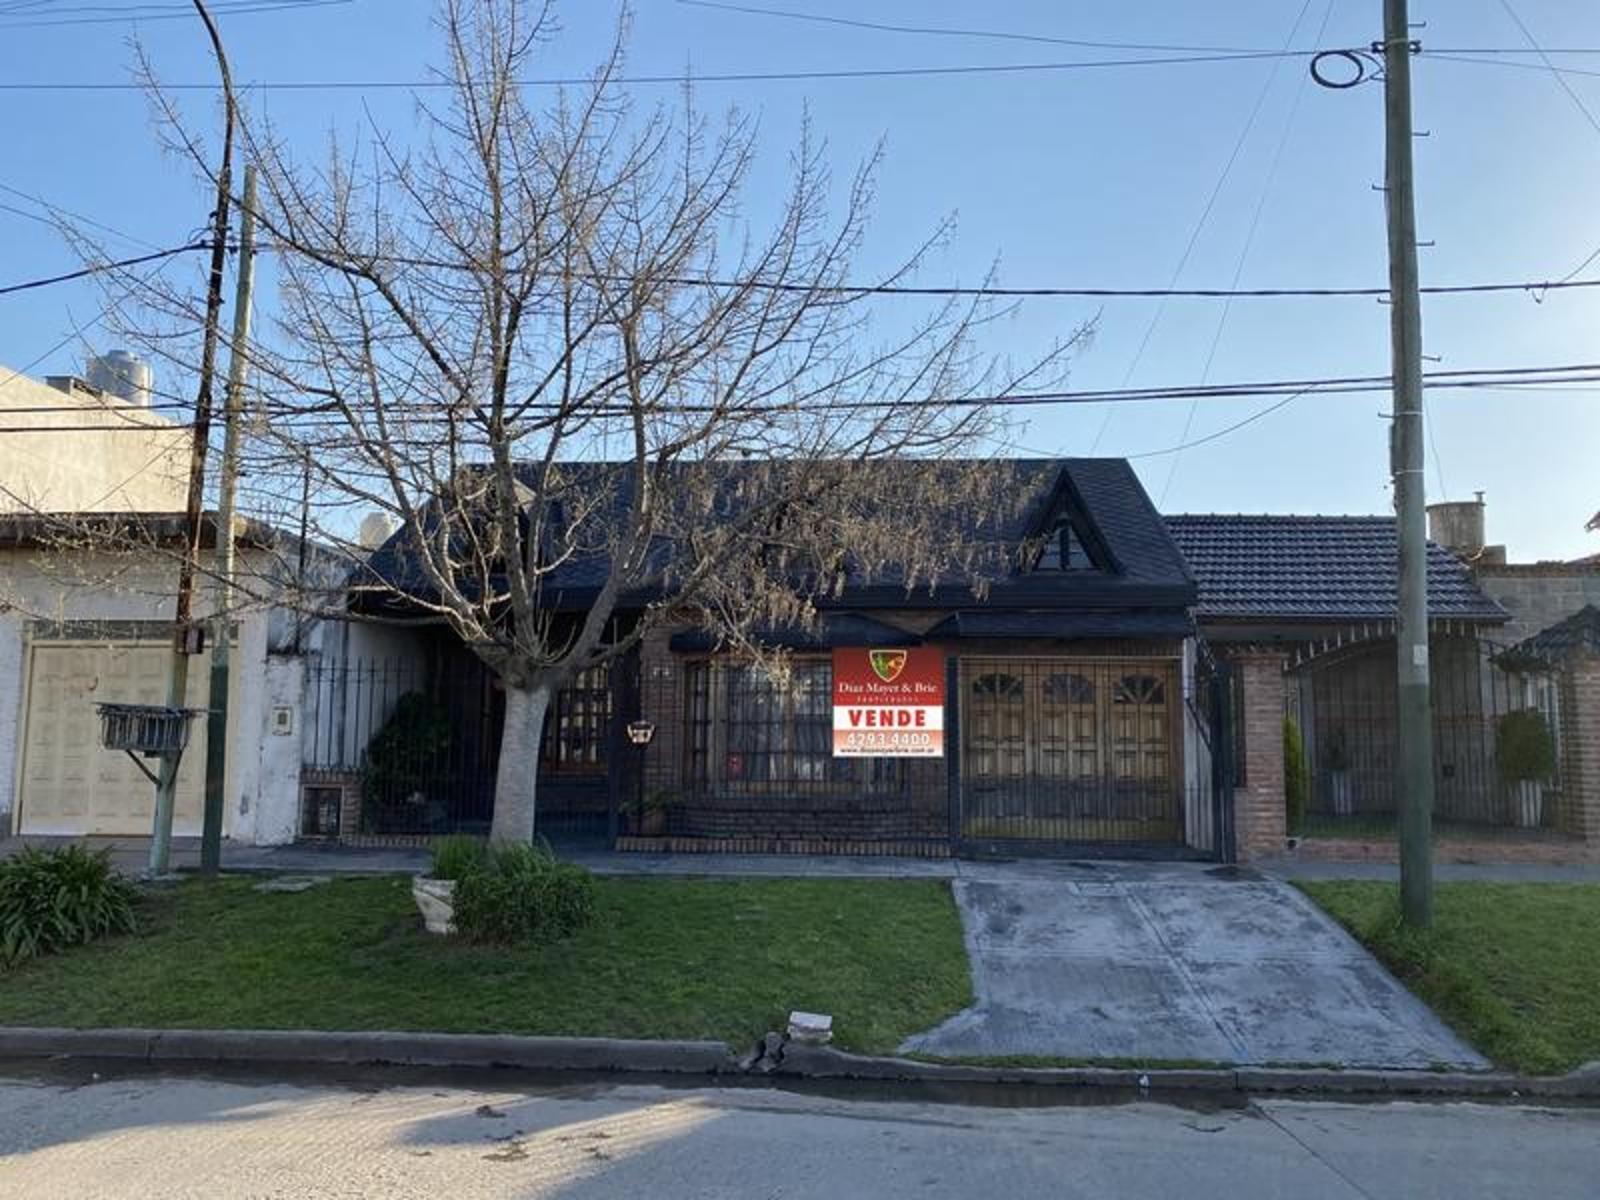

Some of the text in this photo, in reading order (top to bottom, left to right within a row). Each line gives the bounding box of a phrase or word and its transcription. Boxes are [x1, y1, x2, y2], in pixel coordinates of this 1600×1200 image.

[866, 682, 899, 695] Mayer
[901, 682, 912, 693] &
[915, 682, 937, 693] Brie
[848, 709, 926, 727] VENDE
[847, 732, 930, 746] 4293 4400
